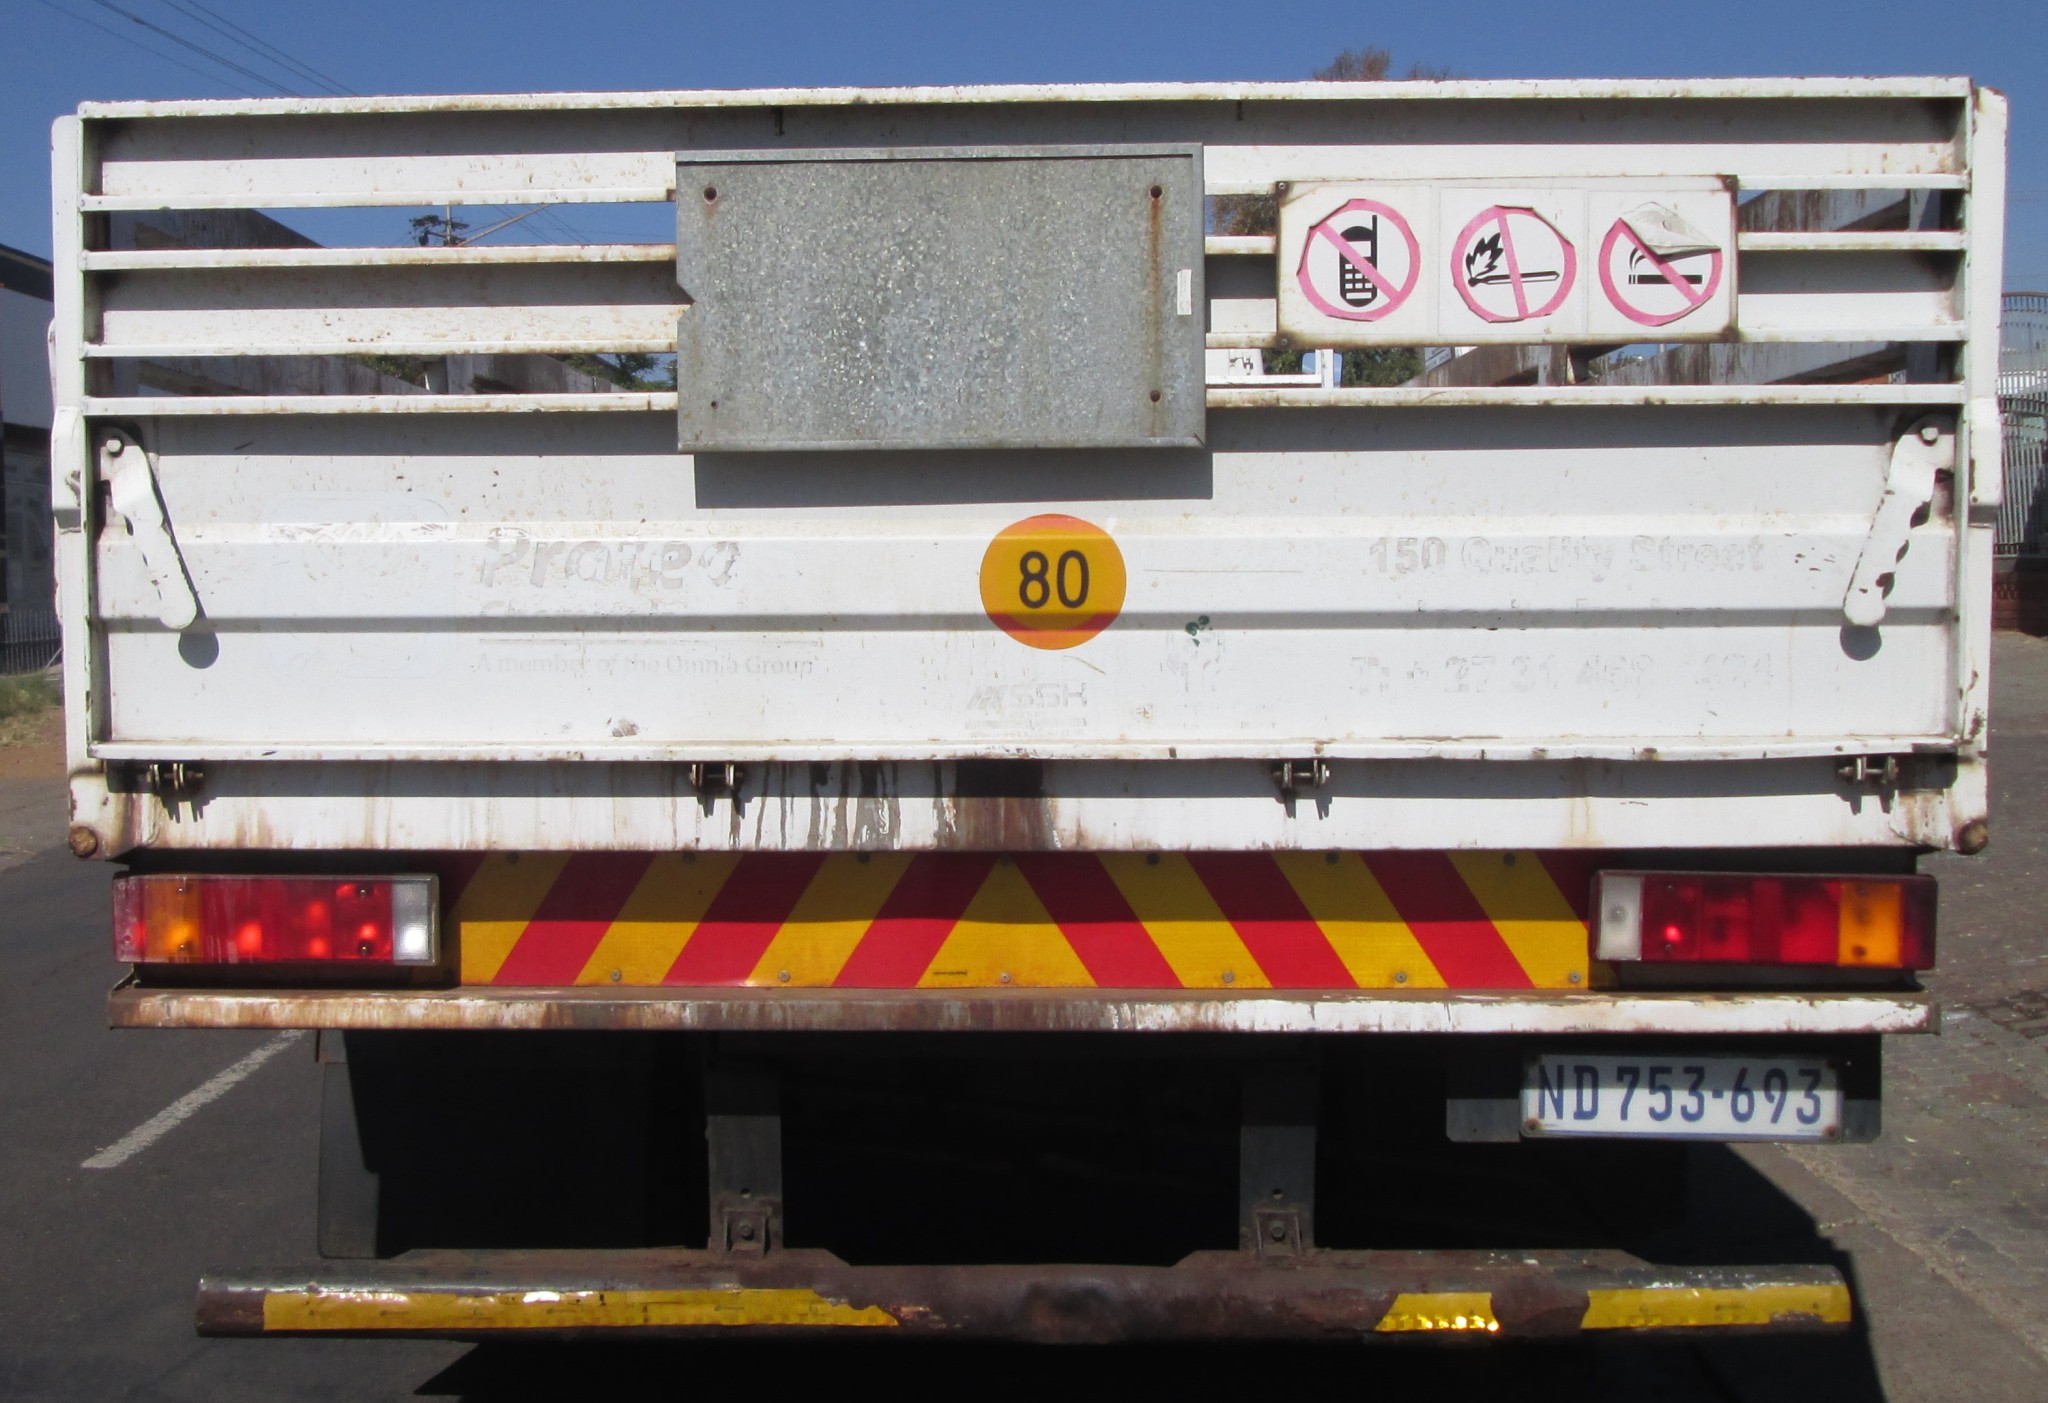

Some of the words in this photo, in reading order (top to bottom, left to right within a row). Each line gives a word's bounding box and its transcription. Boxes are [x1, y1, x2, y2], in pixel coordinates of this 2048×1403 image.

[1019, 549, 1090, 609] 80
[1369, 536, 1446, 574] 150
[1538, 1065, 1599, 1120] ND
[1616, 1065, 1821, 1124] 753-693
